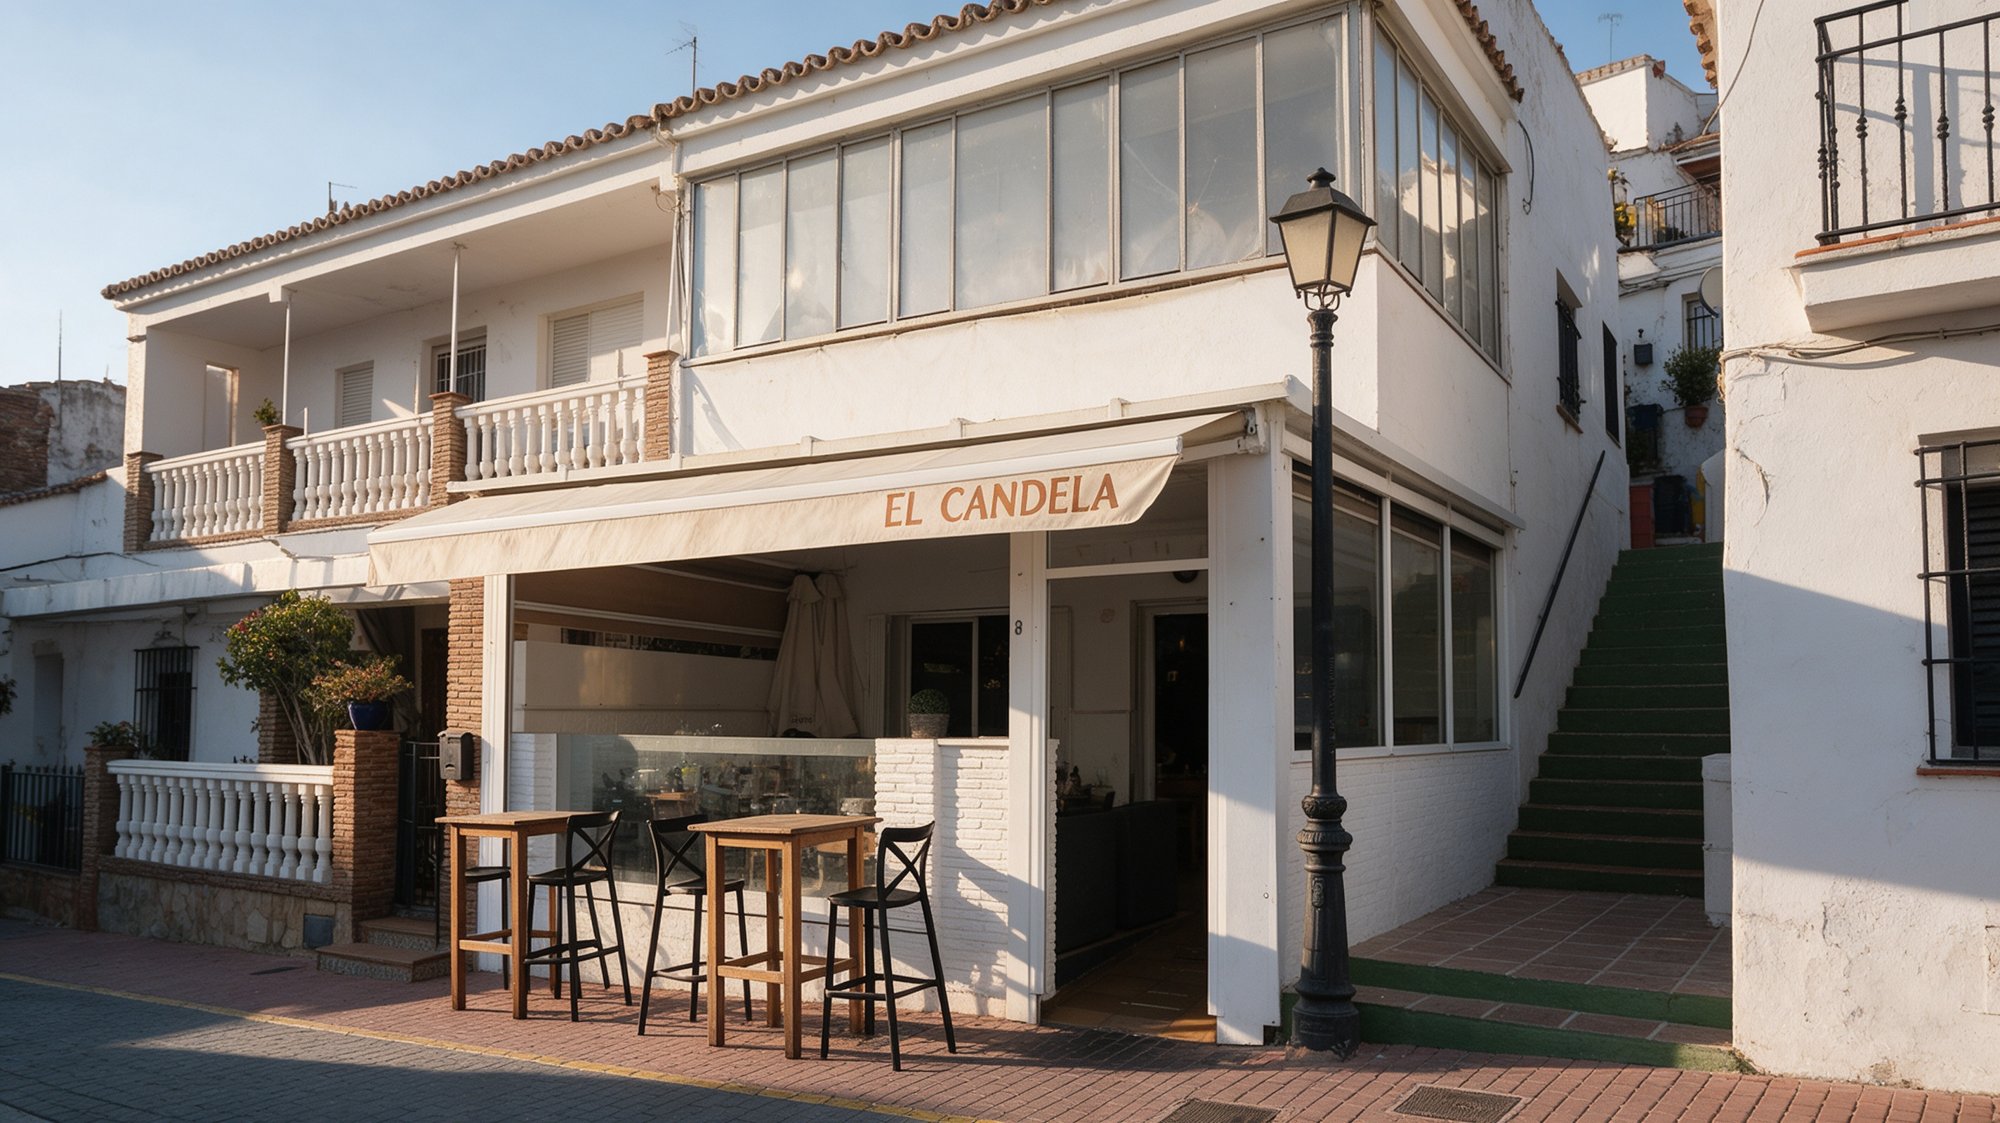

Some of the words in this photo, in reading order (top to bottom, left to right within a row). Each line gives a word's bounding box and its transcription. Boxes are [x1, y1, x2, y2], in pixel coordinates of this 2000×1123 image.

[885, 491, 922, 527] EL
[940, 473, 1119, 522] CANDELA
[1015, 620, 1023, 635] 8
